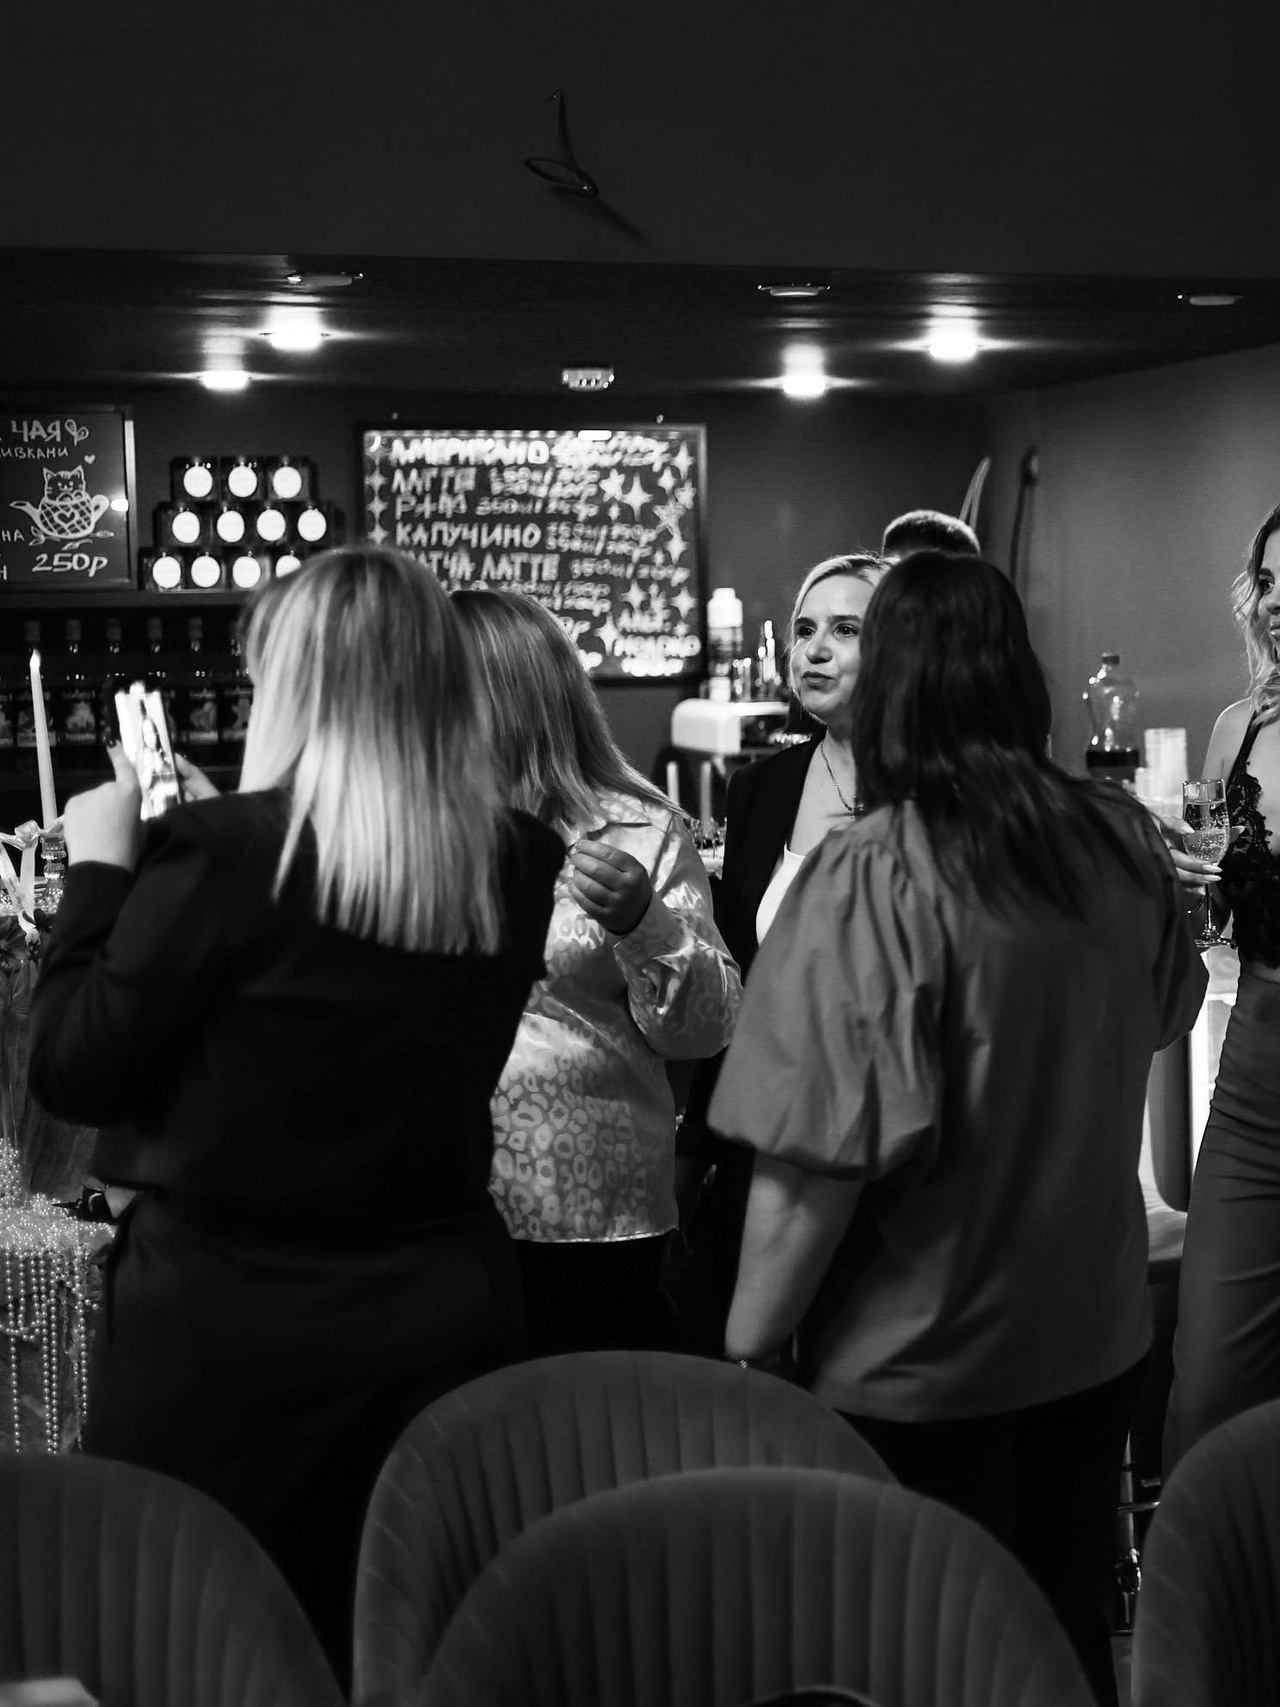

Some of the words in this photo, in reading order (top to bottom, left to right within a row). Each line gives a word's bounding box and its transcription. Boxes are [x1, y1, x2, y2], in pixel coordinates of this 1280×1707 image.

[11, 419, 62, 442] ЧАЯ
[396, 521, 542, 549] КАПУЧИНО
[32, 552, 108, 578] 250р
